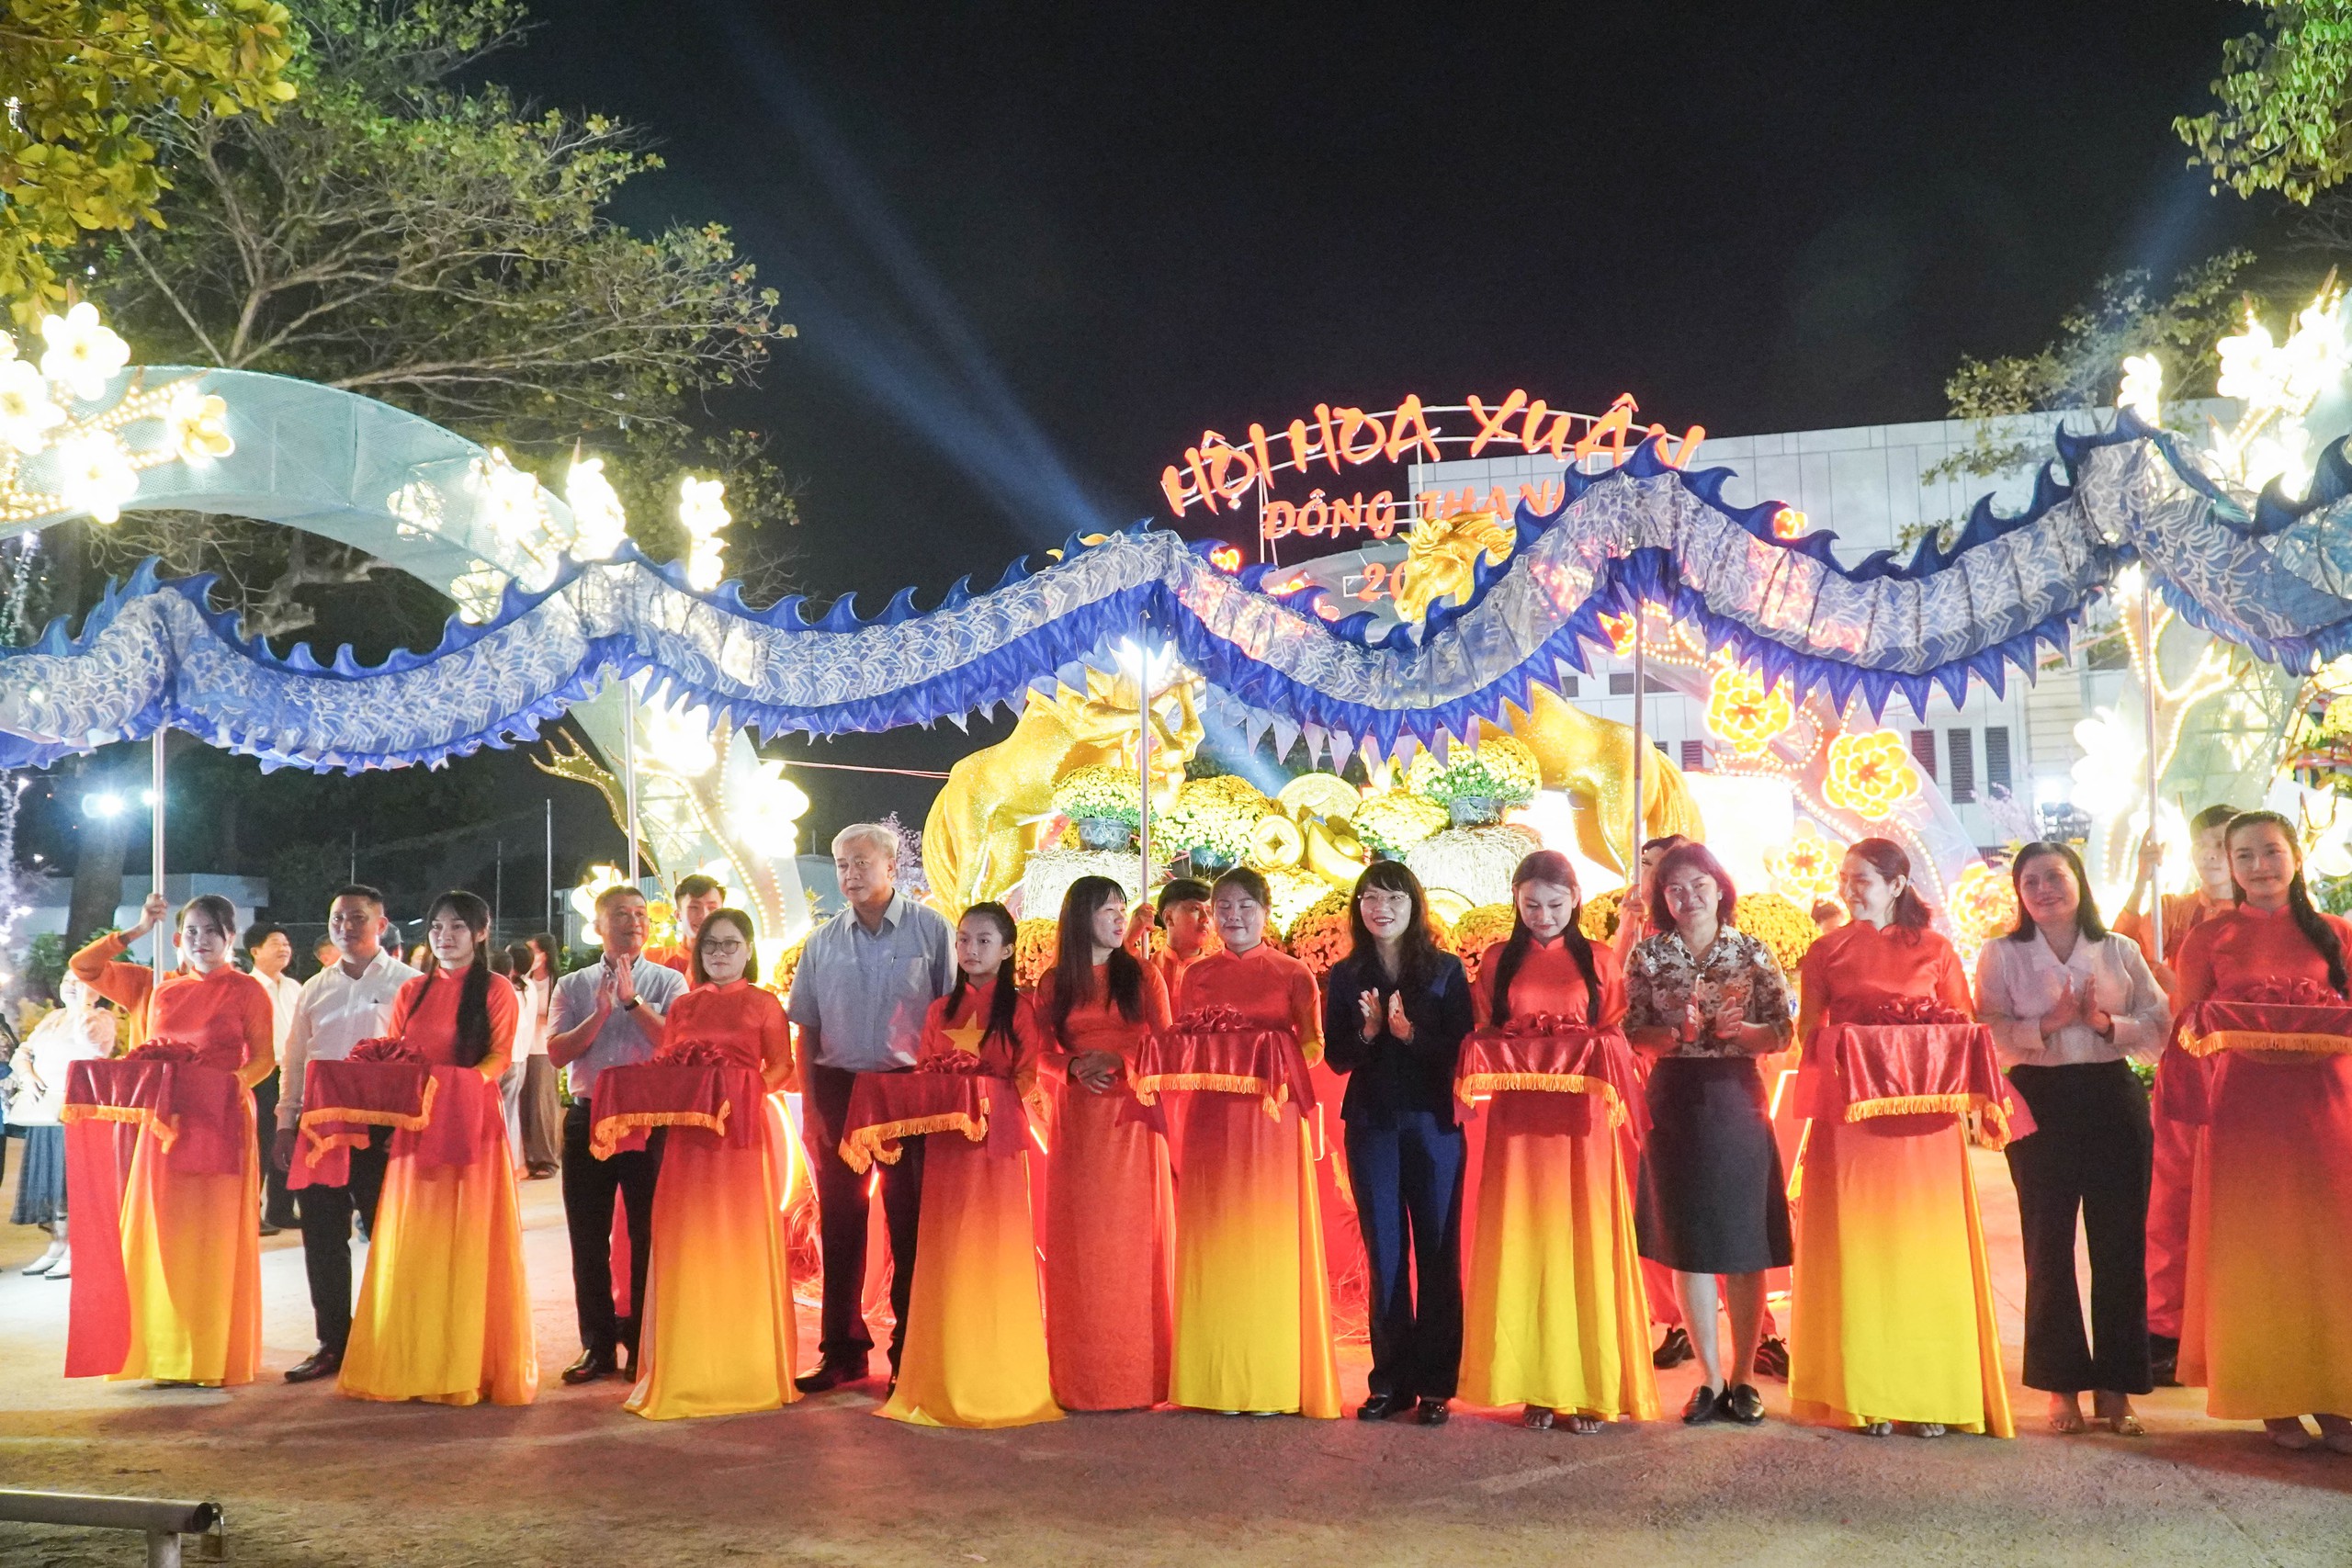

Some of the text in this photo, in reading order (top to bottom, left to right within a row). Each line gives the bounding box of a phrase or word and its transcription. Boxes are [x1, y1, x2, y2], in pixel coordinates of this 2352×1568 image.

[1160, 389, 1706, 518] HỘI HOA XUÂN
[1262, 488, 1396, 539] ĐÔNG
